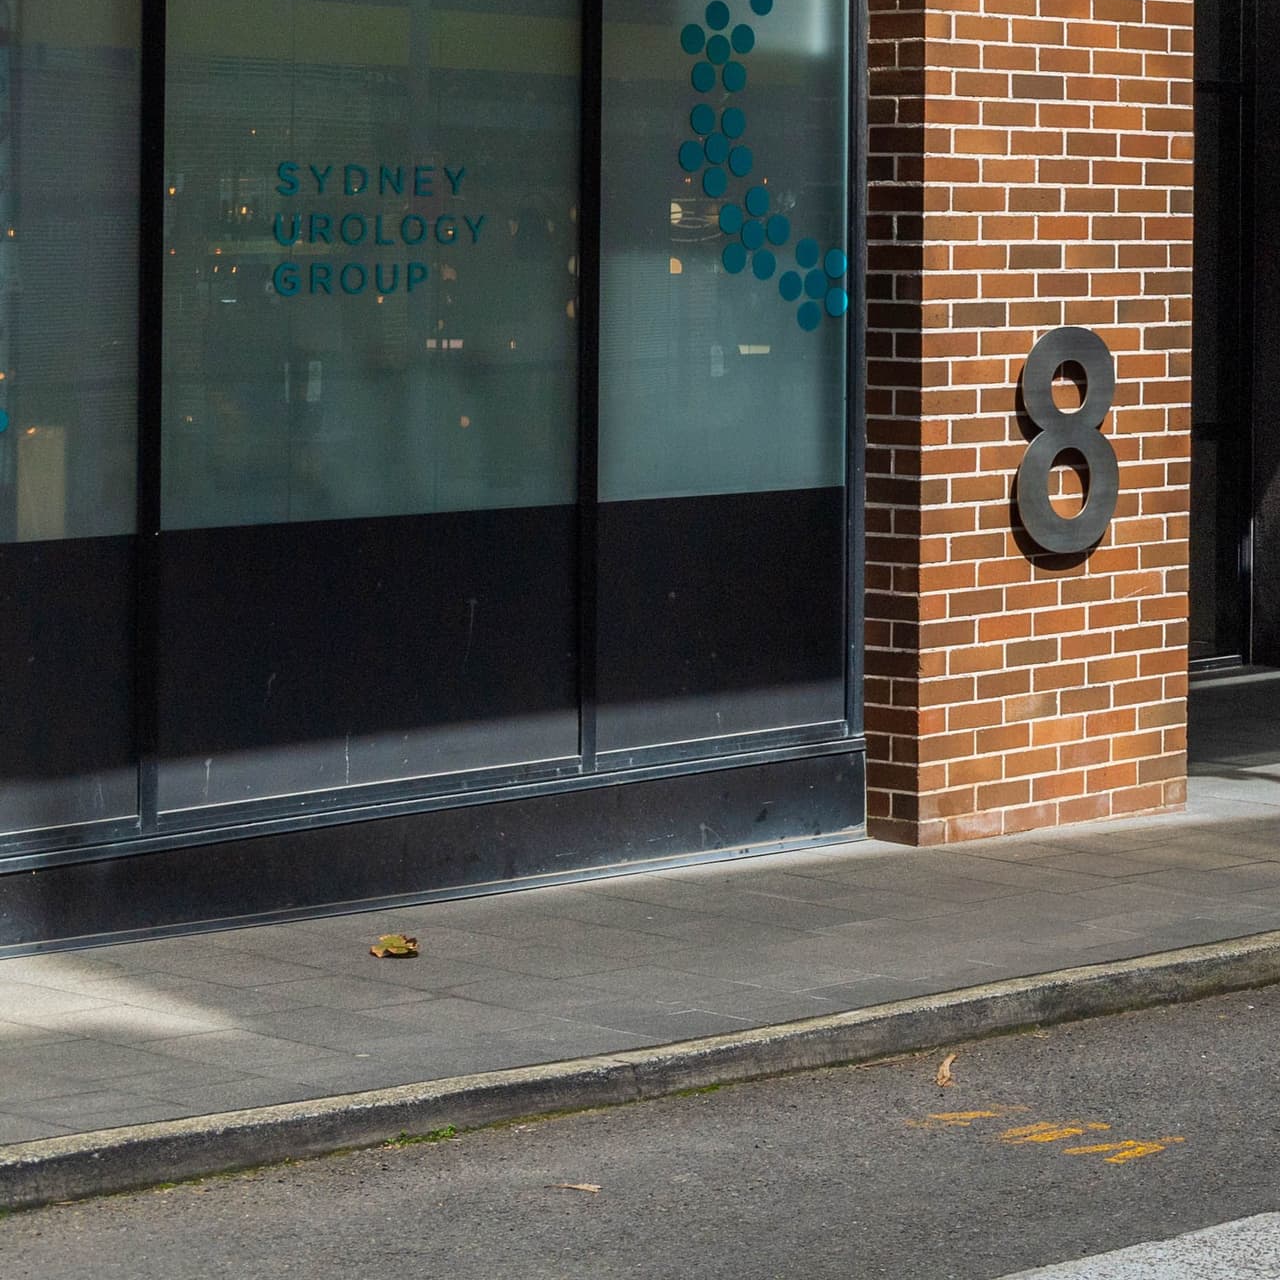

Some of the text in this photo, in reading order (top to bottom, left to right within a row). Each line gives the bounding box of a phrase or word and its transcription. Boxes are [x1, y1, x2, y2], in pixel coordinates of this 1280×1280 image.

[276, 161, 468, 196] SYDNEY
[273, 212, 487, 246] UROLOGY
[273, 262, 429, 296] GROUP
[1017, 326, 1120, 554] 8
